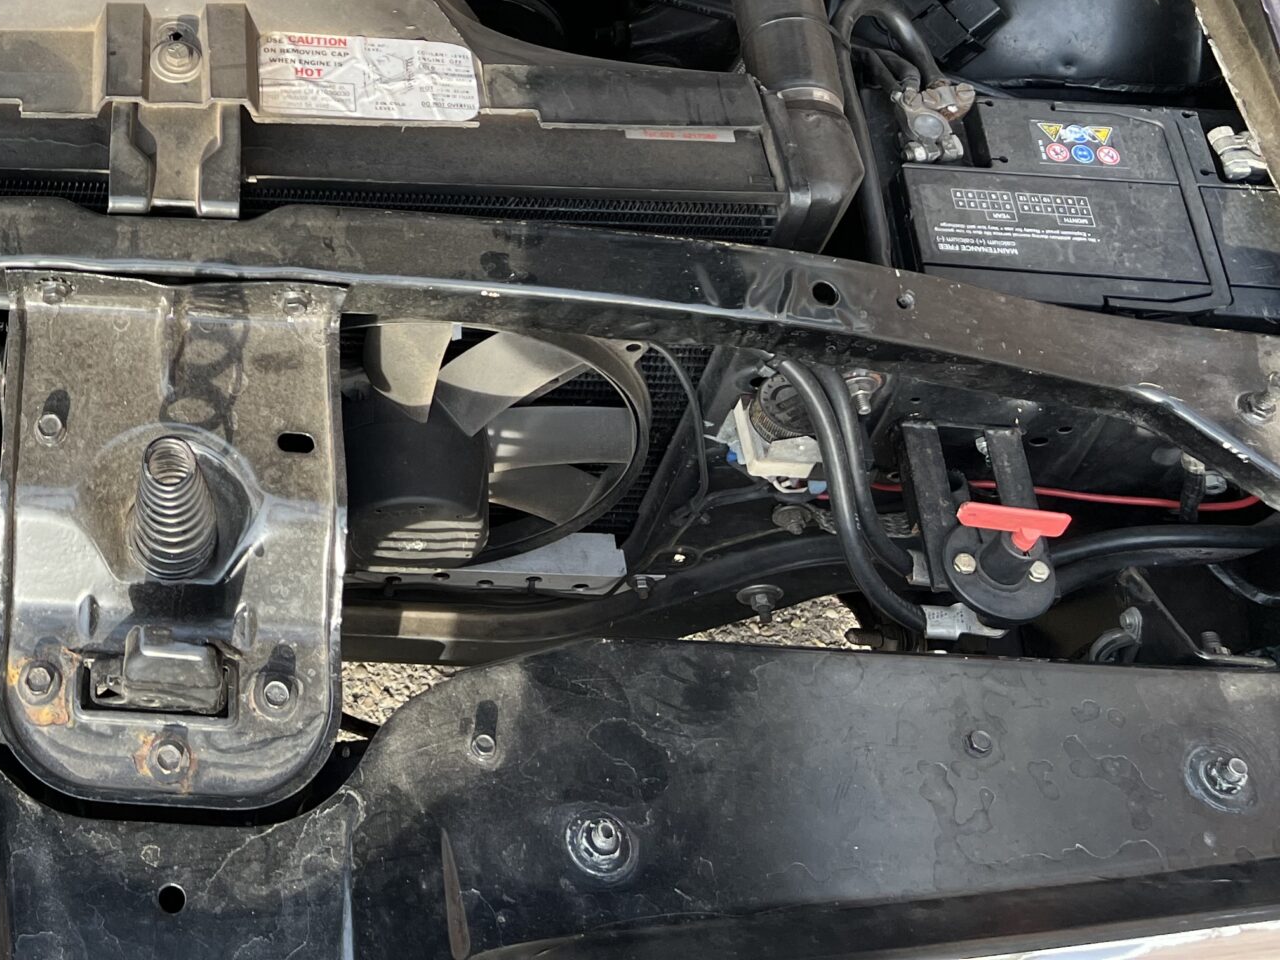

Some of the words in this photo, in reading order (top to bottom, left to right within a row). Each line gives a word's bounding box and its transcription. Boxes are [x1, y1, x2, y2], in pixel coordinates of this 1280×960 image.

[287, 35, 347, 47] CAUTION
[279, 48, 328, 56] REMOVING
[294, 67, 323, 77] HOT
[945, 236, 974, 244] calcium
[938, 243, 960, 251] FREE
[961, 244, 1019, 255] MAINTENANCE
